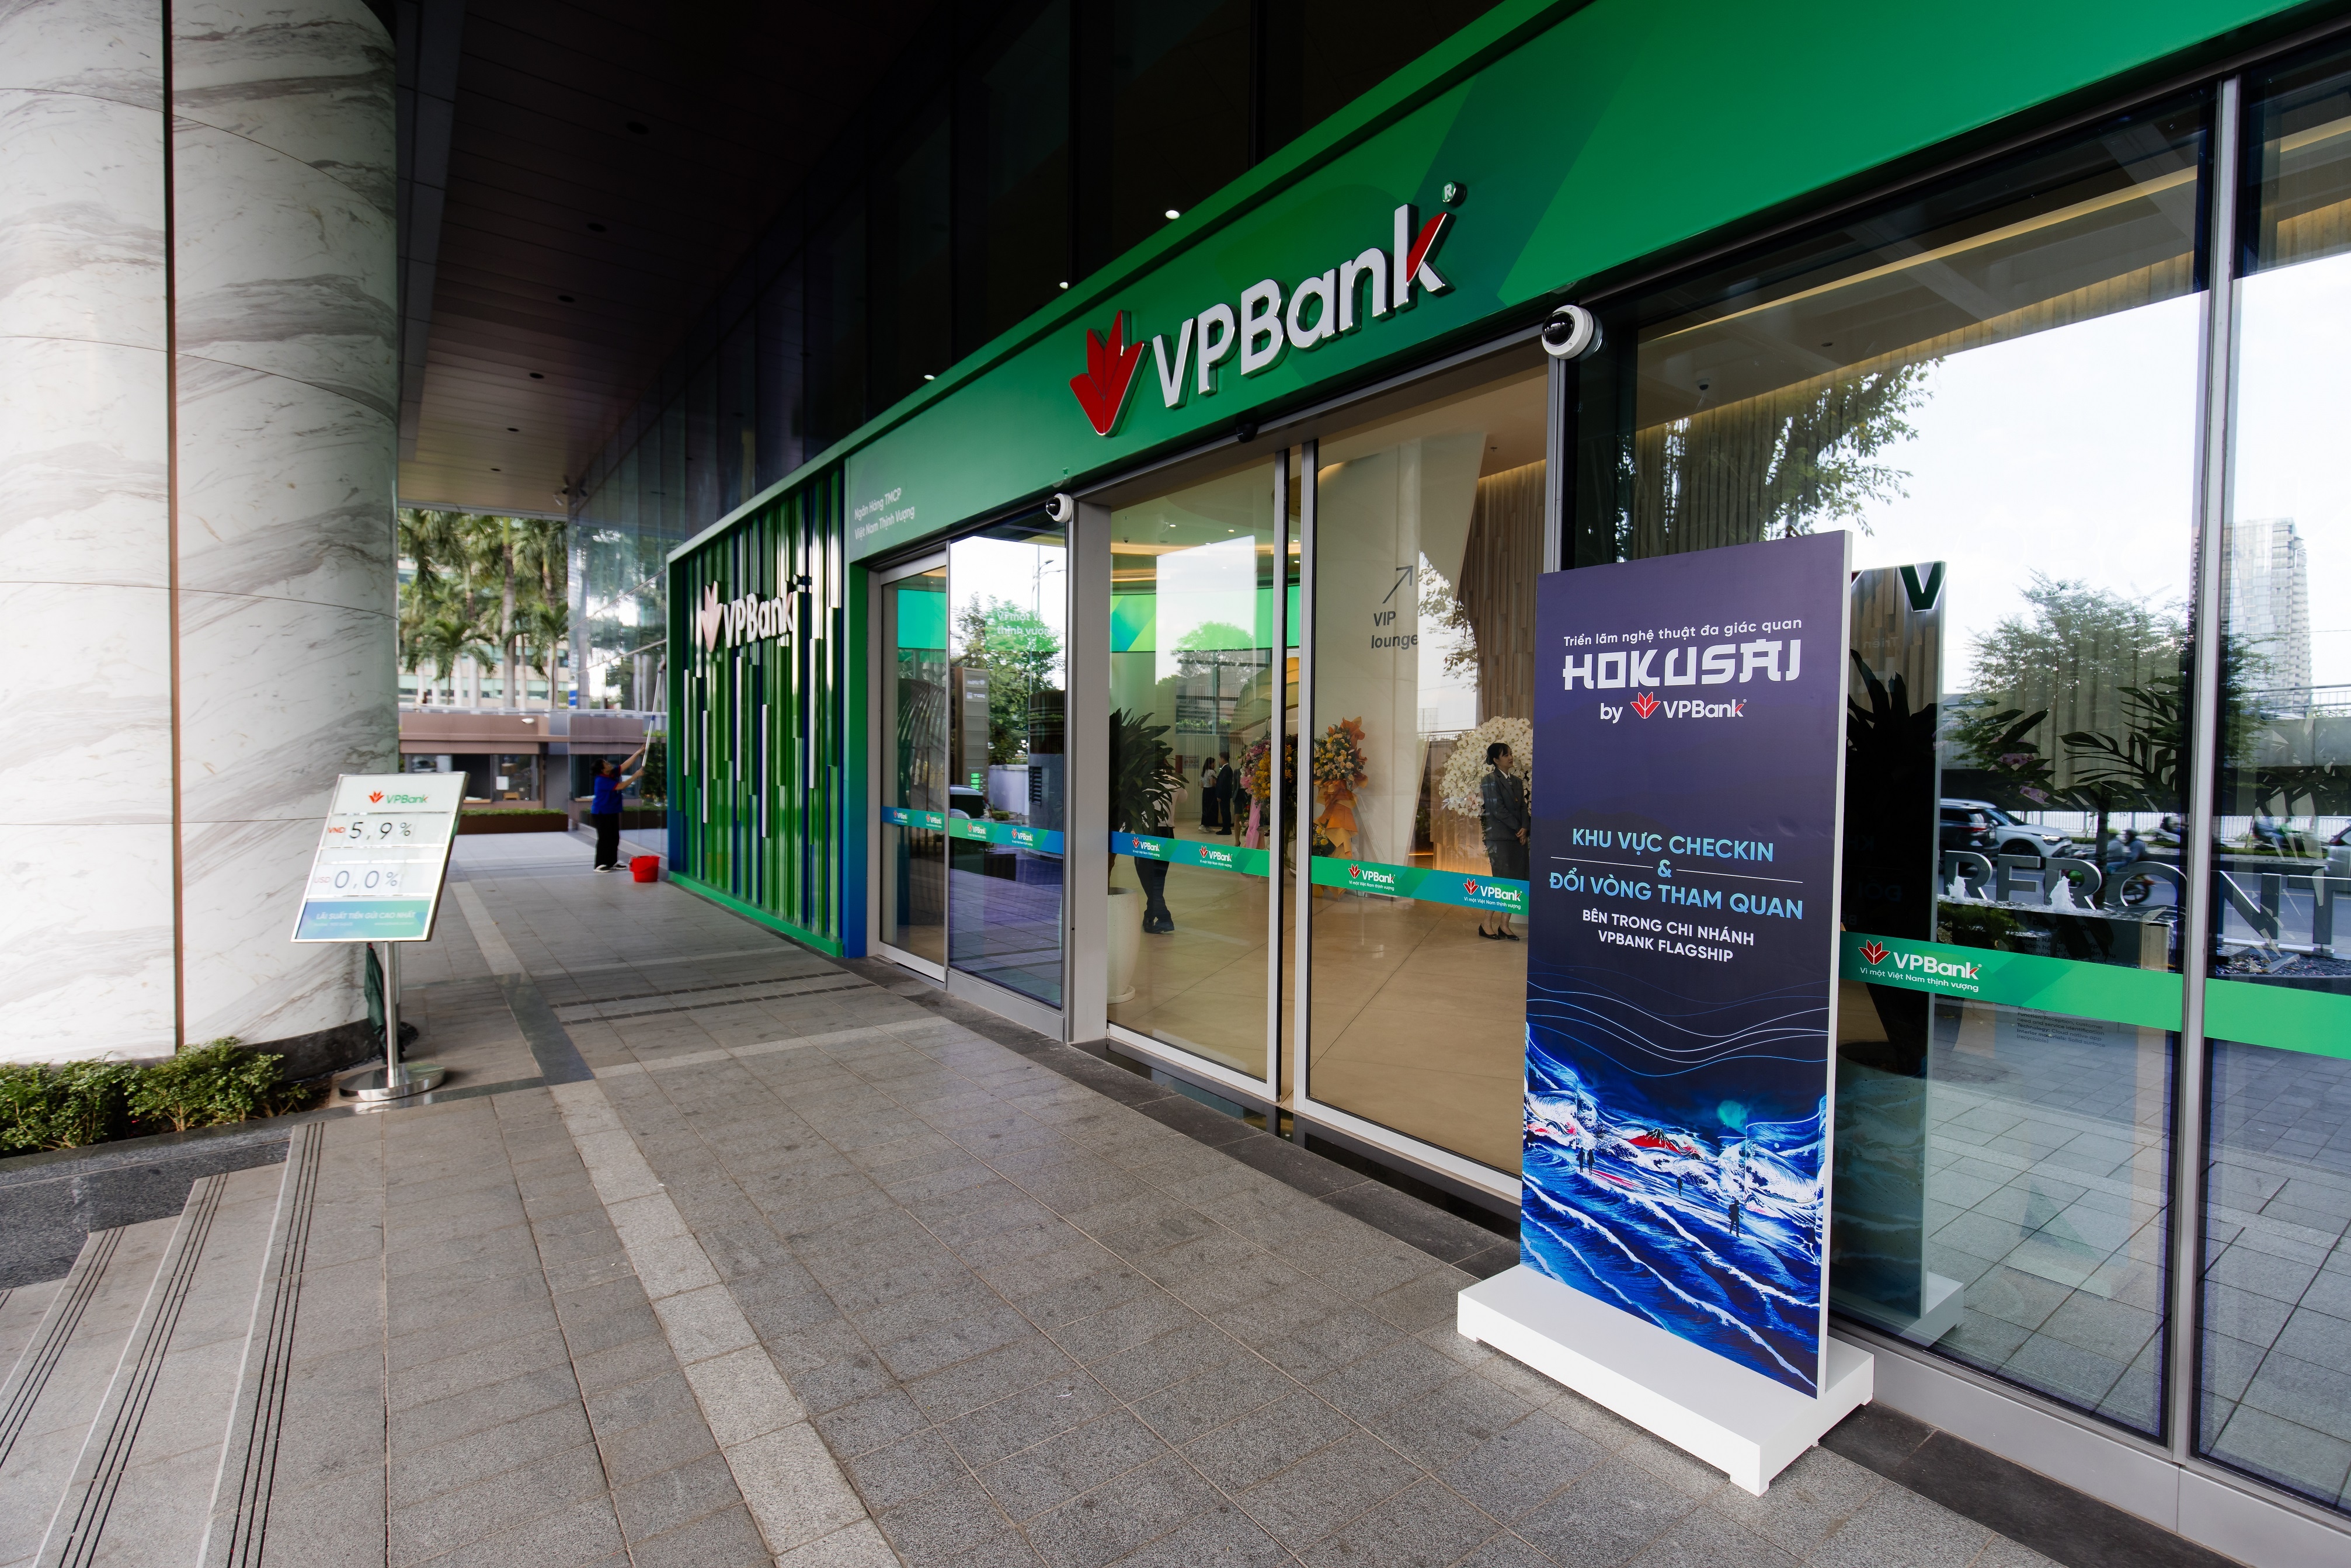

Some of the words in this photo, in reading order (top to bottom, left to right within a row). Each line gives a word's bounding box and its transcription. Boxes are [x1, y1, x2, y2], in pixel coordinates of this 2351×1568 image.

[1153, 203, 1456, 409] VPBank
[854, 505, 868, 521] Ngân
[869, 499, 884, 513] Hàng
[884, 488, 902, 505] TMCP
[854, 527, 865, 541] Việt
[865, 522, 878, 535] Nam
[879, 513, 894, 530] Thịnh
[895, 506, 914, 522] Vượng
[724, 580, 793, 648] VPBank
[1373, 610, 1396, 627] VIP
[1371, 634, 1418, 649] lounge
[1564, 632, 1592, 646] Triển
[1595, 632, 1618, 645] lãm
[1622, 630, 1654, 644] nghệ
[1658, 625, 1696, 641] thuật
[1700, 623, 1719, 636] đa
[1724, 620, 1757, 638] giác
[1761, 618, 1802, 634] quan
[1563, 638, 1801, 690] HOKUSAI
[1600, 703, 1623, 724] by
[1663, 699, 1744, 718] VPBank
[386, 794, 429, 804] VPBank
[1140, 842, 1160, 851] VPBank
[1573, 828, 1612, 848] KHU
[1618, 832, 1663, 856] VỰC
[1669, 835, 1774, 862] CHECKIN
[1209, 851, 1232, 862] VPBank
[1362, 870, 1394, 884] VPBank
[1657, 858, 1672, 878] &
[1480, 885, 1521, 902] VPBank
[1549, 867, 1585, 892] ĐỔI
[1590, 874, 1651, 901] VÒNG
[1658, 884, 1722, 910] THAM
[1730, 892, 1803, 920] QUAN
[1583, 908, 1608, 924] BÊN
[1612, 913, 1662, 932] TRONG
[1666, 921, 1693, 936] CHI
[1698, 926, 1754, 946] NHÁNH
[1598, 930, 1654, 950] VPBANK
[1658, 939, 1733, 963] FLAGSHIP
[1893, 952, 1979, 980] VPBank
[1869, 969, 1886, 978] một
[1887, 971, 1904, 981] Việt
[1905, 974, 1925, 983] Nam
[1926, 978, 1949, 987] thịnh
[1950, 982, 1979, 993] vượng
[2017, 1023, 2050, 1032] Technology:
[2044, 1016, 2074, 1025] Reception,
[2065, 1025, 2105, 1036] identification
[2016, 1028, 2037, 1036] Interior
[2016, 1033, 2049, 1044] (recyclable)
